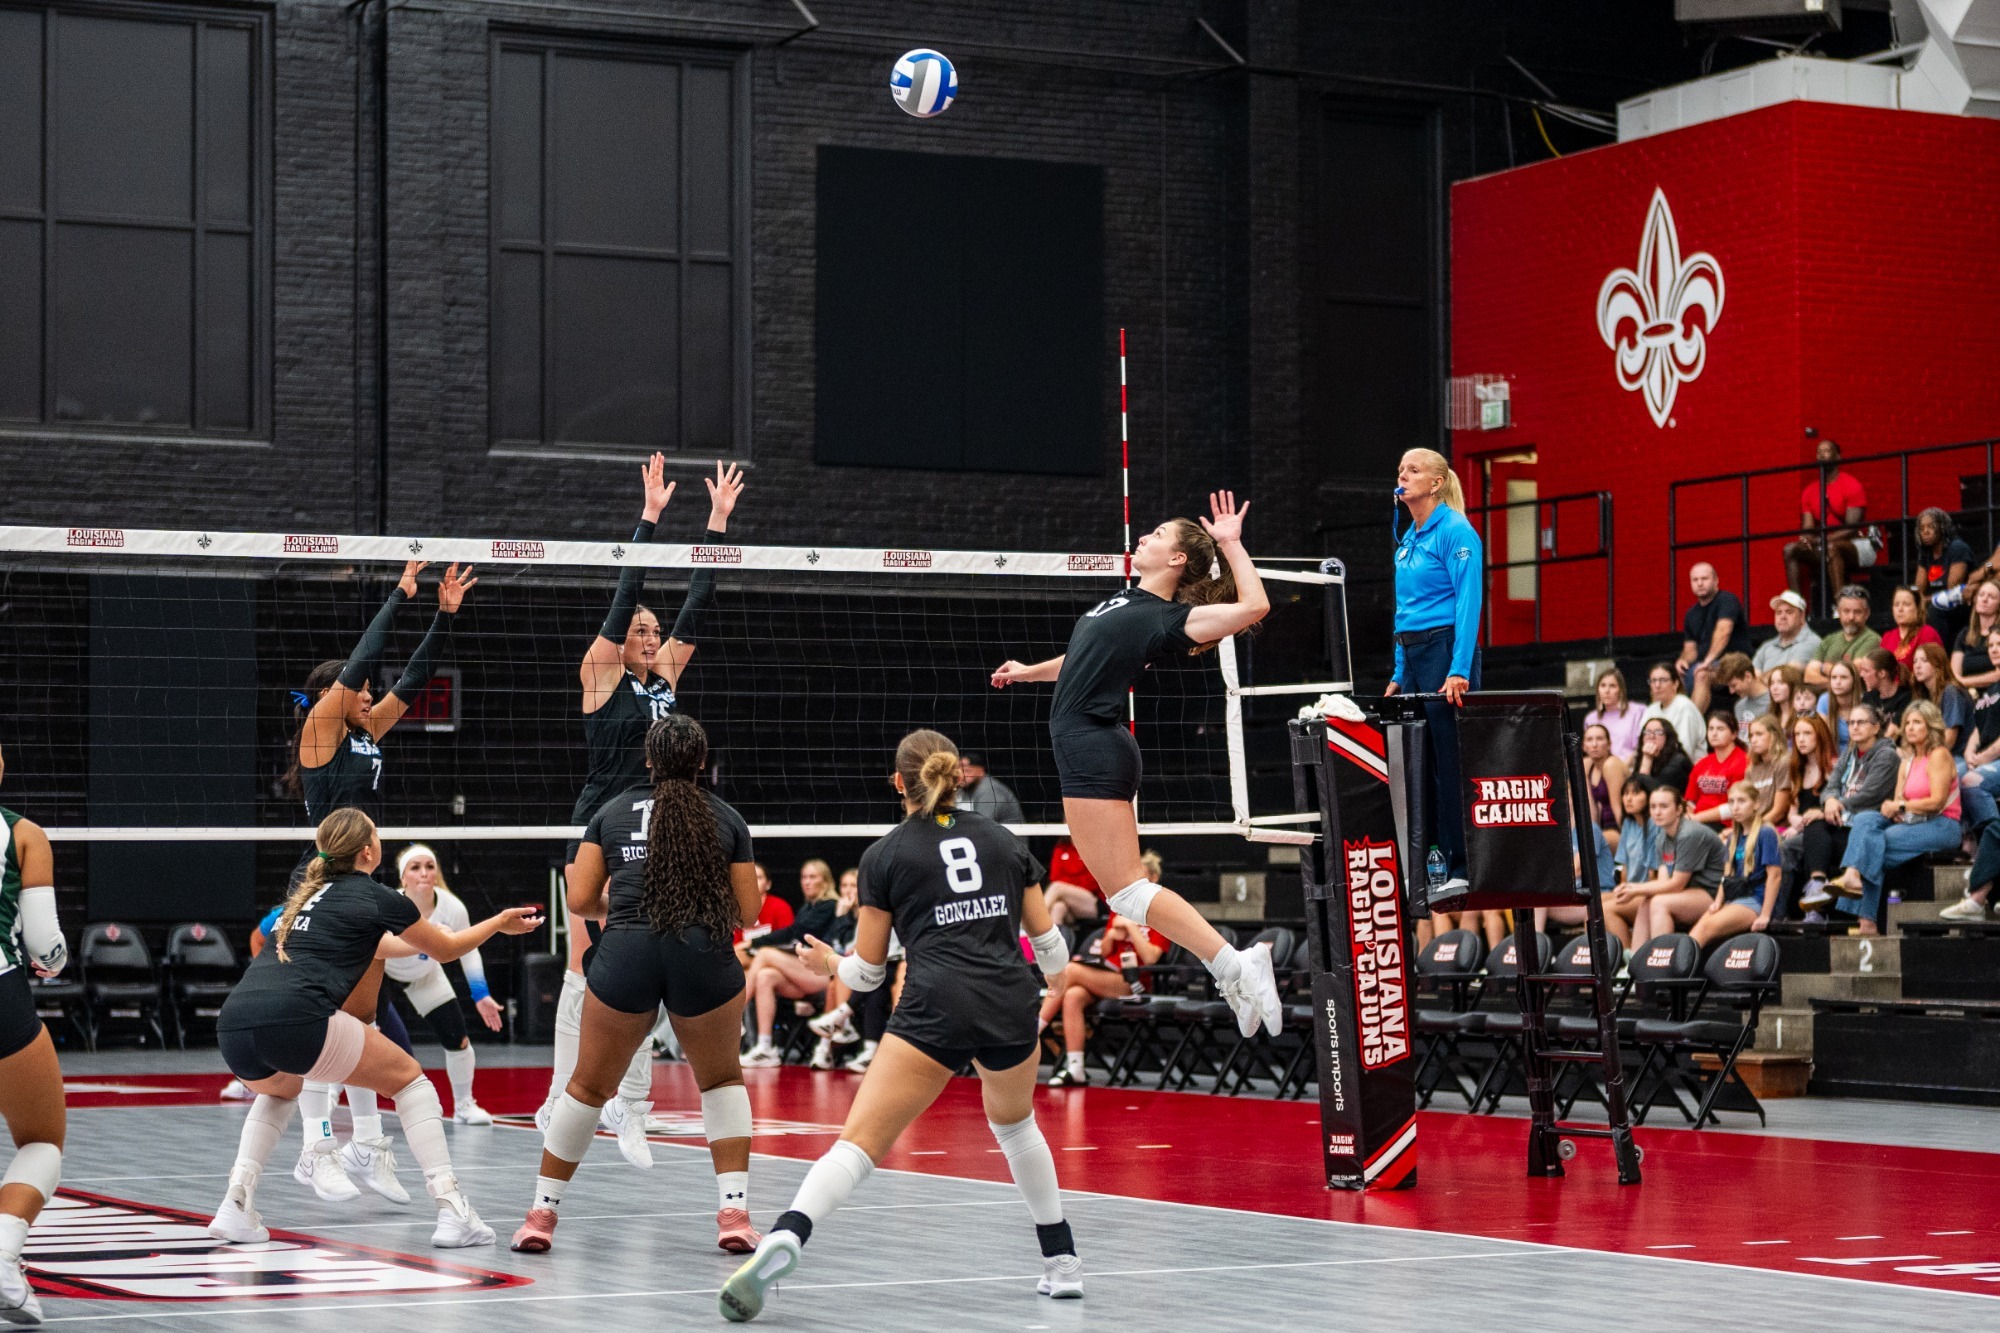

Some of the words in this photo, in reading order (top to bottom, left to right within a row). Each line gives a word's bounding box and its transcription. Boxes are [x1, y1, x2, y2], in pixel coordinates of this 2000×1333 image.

[70, 530, 123, 540] LOUISIANA
[286, 536, 337, 546] LOUISIANA
[493, 542, 543, 551] LOUISIANA
[693, 547, 740, 556] LOUISIANA
[885, 552, 931, 561] LOUISIANA
[1069, 556, 1113, 564] LOUISIANA
[1086, 597, 1130, 617] 17
[371, 757, 383, 790] 7
[1474, 803, 1550, 824] CAJUNS
[939, 837, 983, 894] 8
[935, 895, 1008, 926] GONZALEZ
[1369, 846, 1407, 1062] LOUISIANA
[1859, 938, 1873, 972] 2
[1356, 951, 1383, 1067] CAJUNS
[1326, 999, 1339, 1048] sports
[1776, 1017, 1783, 1050] 1
[1331, 1051, 1344, 1111] imports
[1329, 1145, 1355, 1155] CAJUNS
